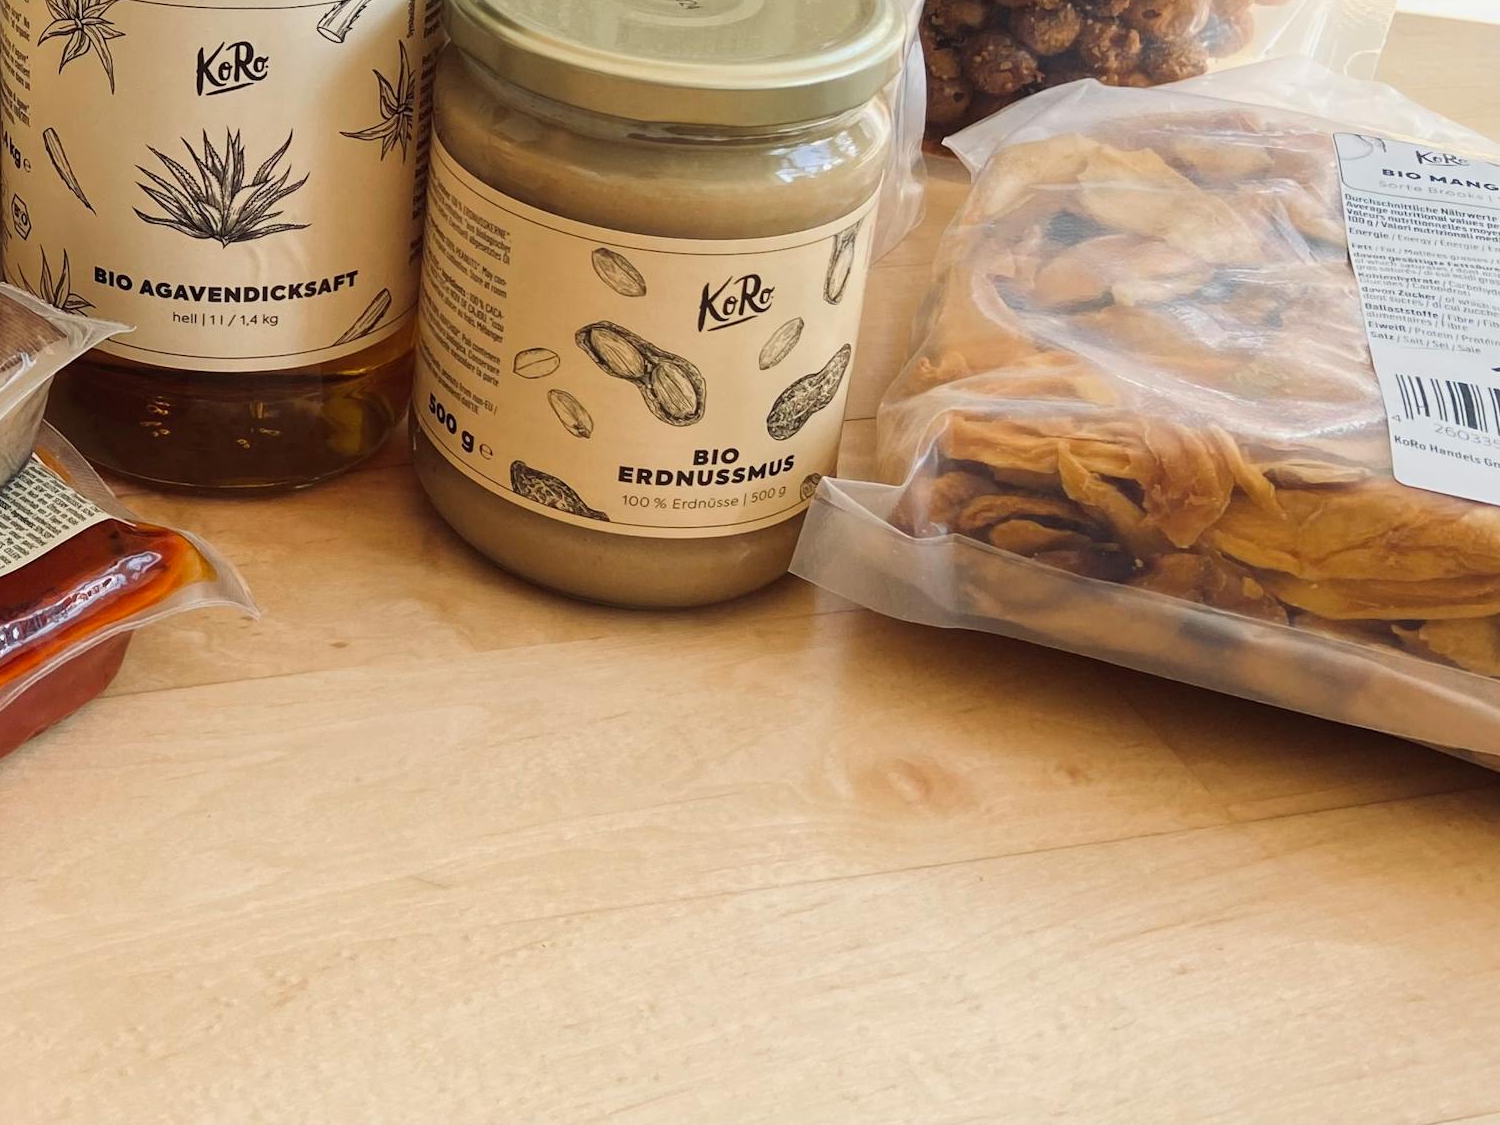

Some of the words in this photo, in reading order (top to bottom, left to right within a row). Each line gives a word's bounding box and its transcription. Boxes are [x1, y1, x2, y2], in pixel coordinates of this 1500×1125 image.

[196, 41, 269, 96] KoRo
[1415, 150, 1470, 167] KoRo
[1382, 168, 1421, 179] BIO
[1429, 175, 1500, 191] MANG
[93, 265, 134, 291] BIO
[138, 269, 359, 303] AGAVENDICKSAFT
[172, 310, 198, 325] hell
[240, 313, 259, 327] 1,4
[262, 310, 279, 326] kg
[698, 273, 775, 333] KoRo
[429, 392, 457, 435] 500
[461, 430, 474, 453] g
[617, 454, 795, 488] ERDNUSSMUS
[692, 447, 740, 468] BIO
[621, 494, 650, 510] 100
[653, 498, 668, 510] %
[671, 495, 739, 511] Erdnüsse
[750, 484, 777, 504] 500
[777, 483, 787, 499] g
